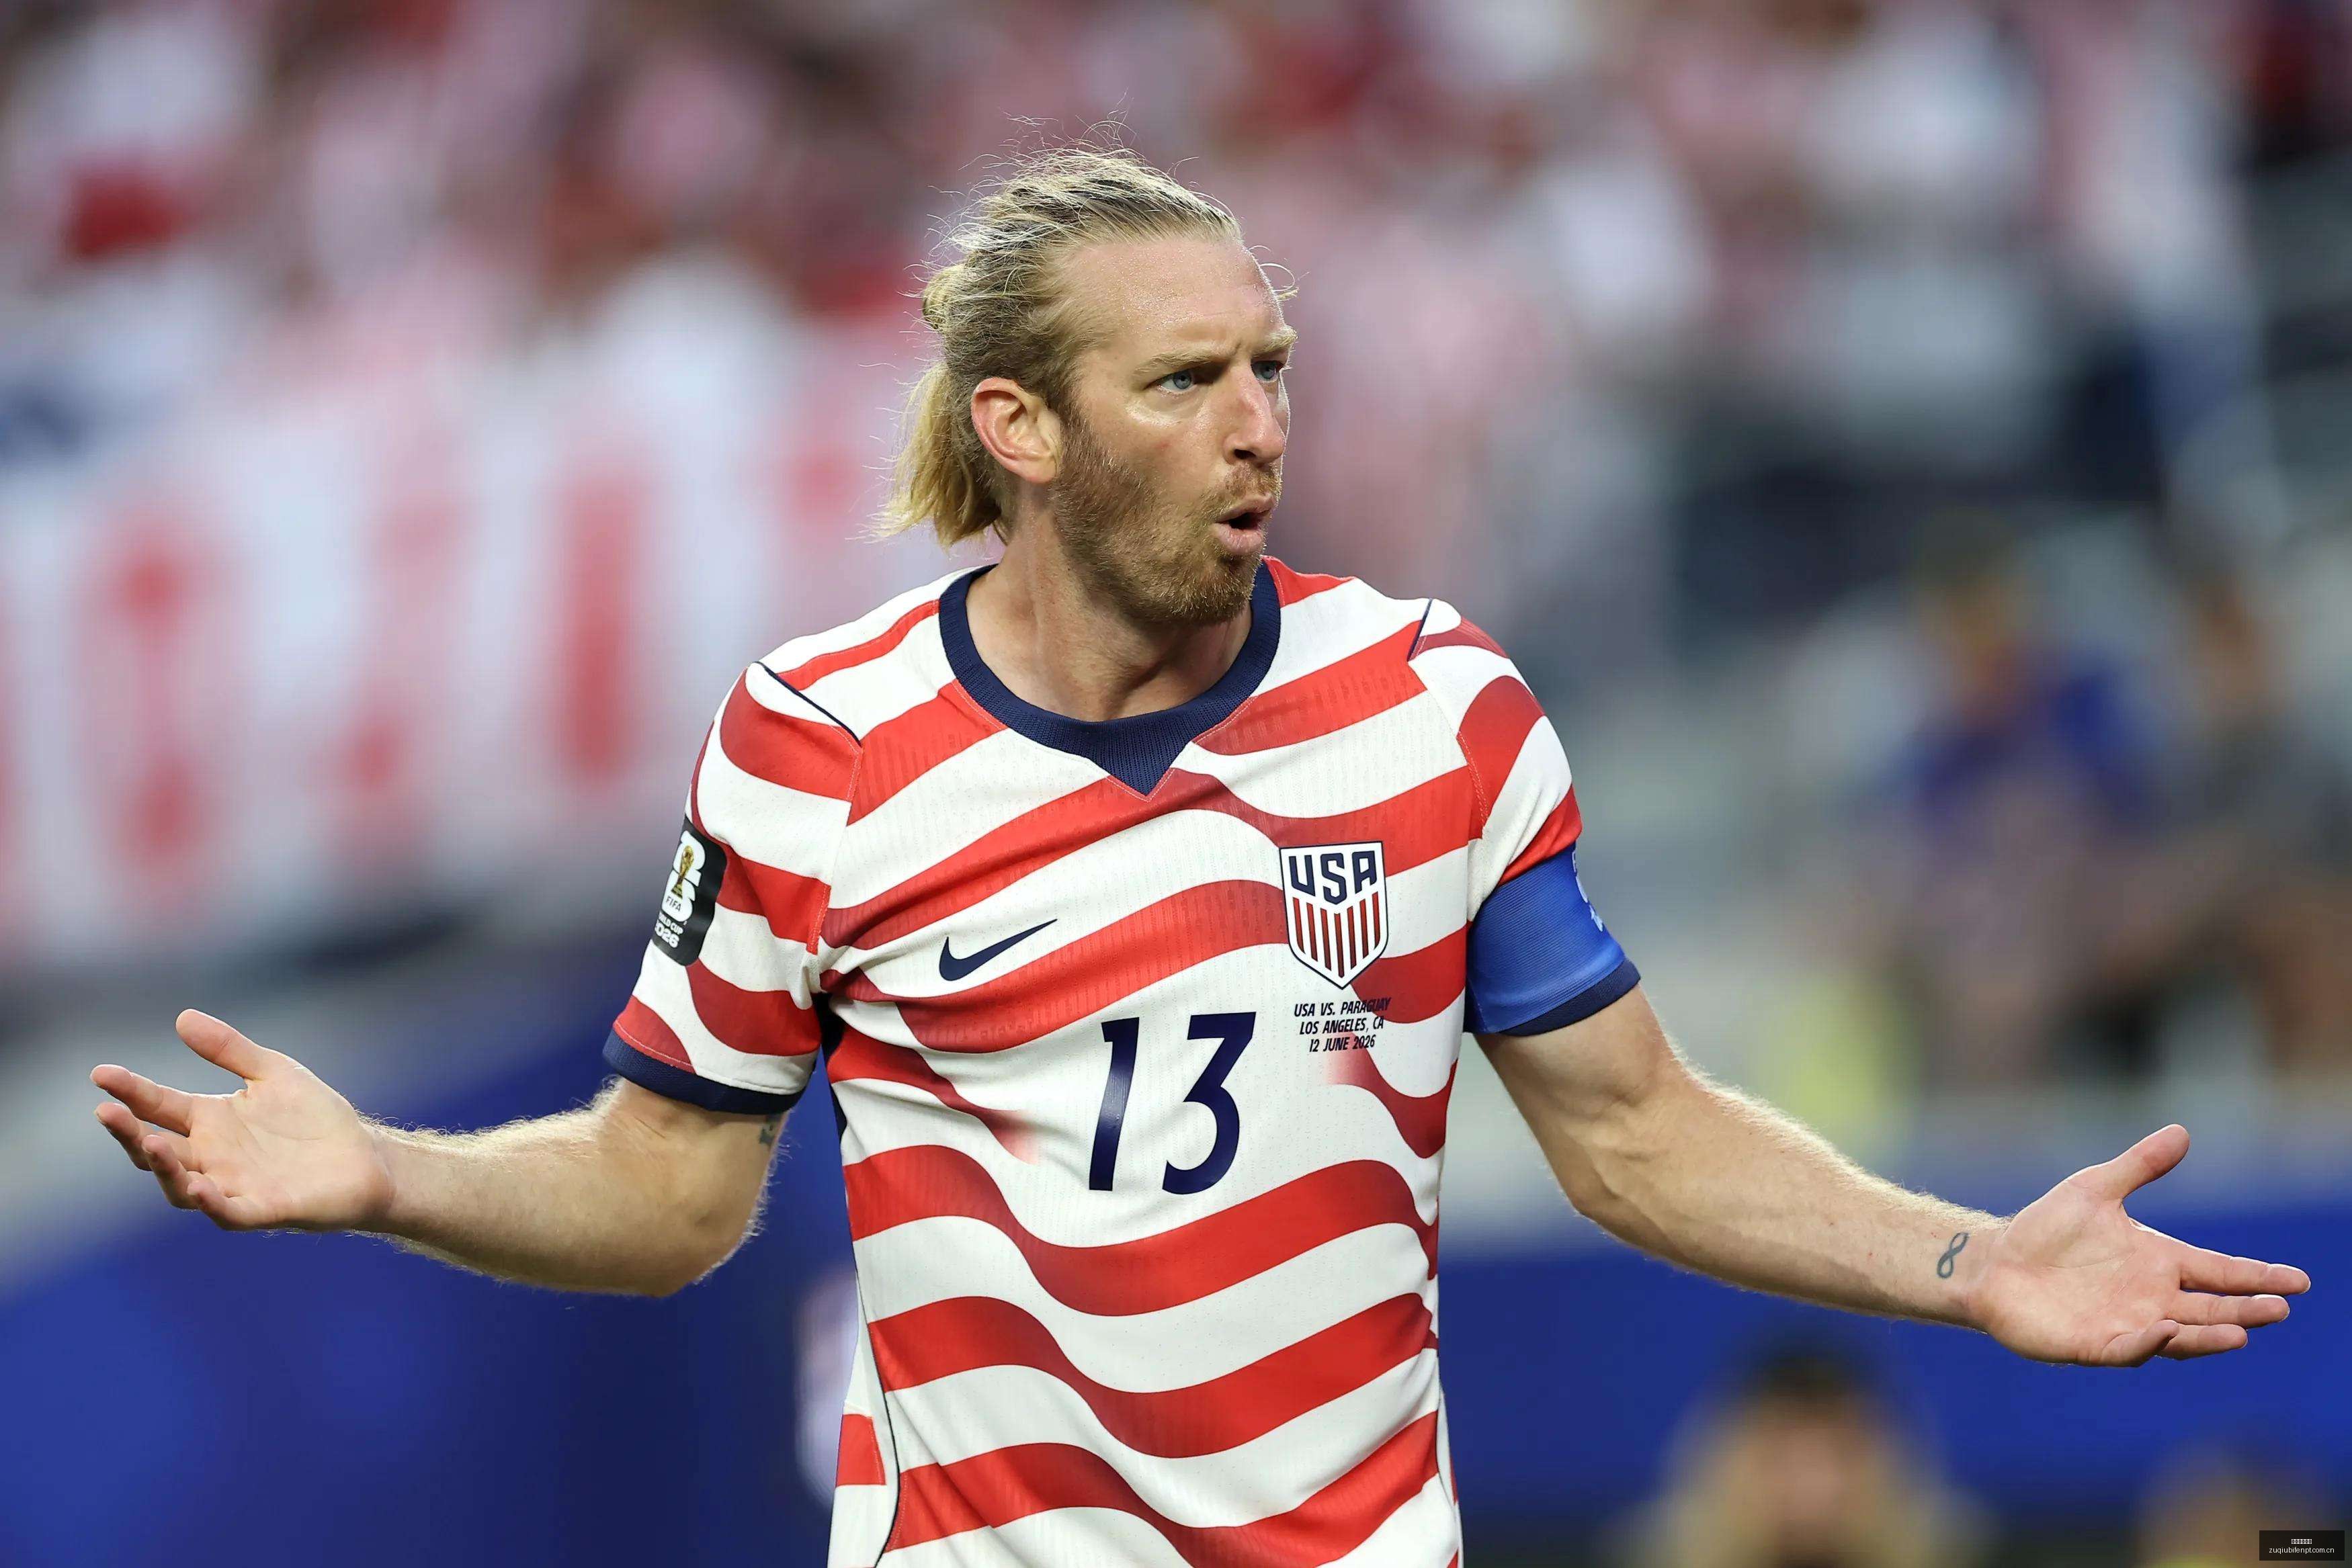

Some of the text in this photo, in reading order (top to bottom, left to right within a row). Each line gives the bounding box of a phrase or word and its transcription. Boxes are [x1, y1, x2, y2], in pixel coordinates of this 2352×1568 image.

[1288, 851, 1377, 905] USA
[666, 896, 681, 912] FIFA
[670, 922, 683, 935] CUP
[1294, 998, 1392, 1017] USA VS. PARAGUAY
[1300, 1016, 1384, 1035] LOS ANGELES, CA
[1309, 1035, 1376, 1053] 12 JUNE 2026
[1089, 1012, 1256, 1194] 13
